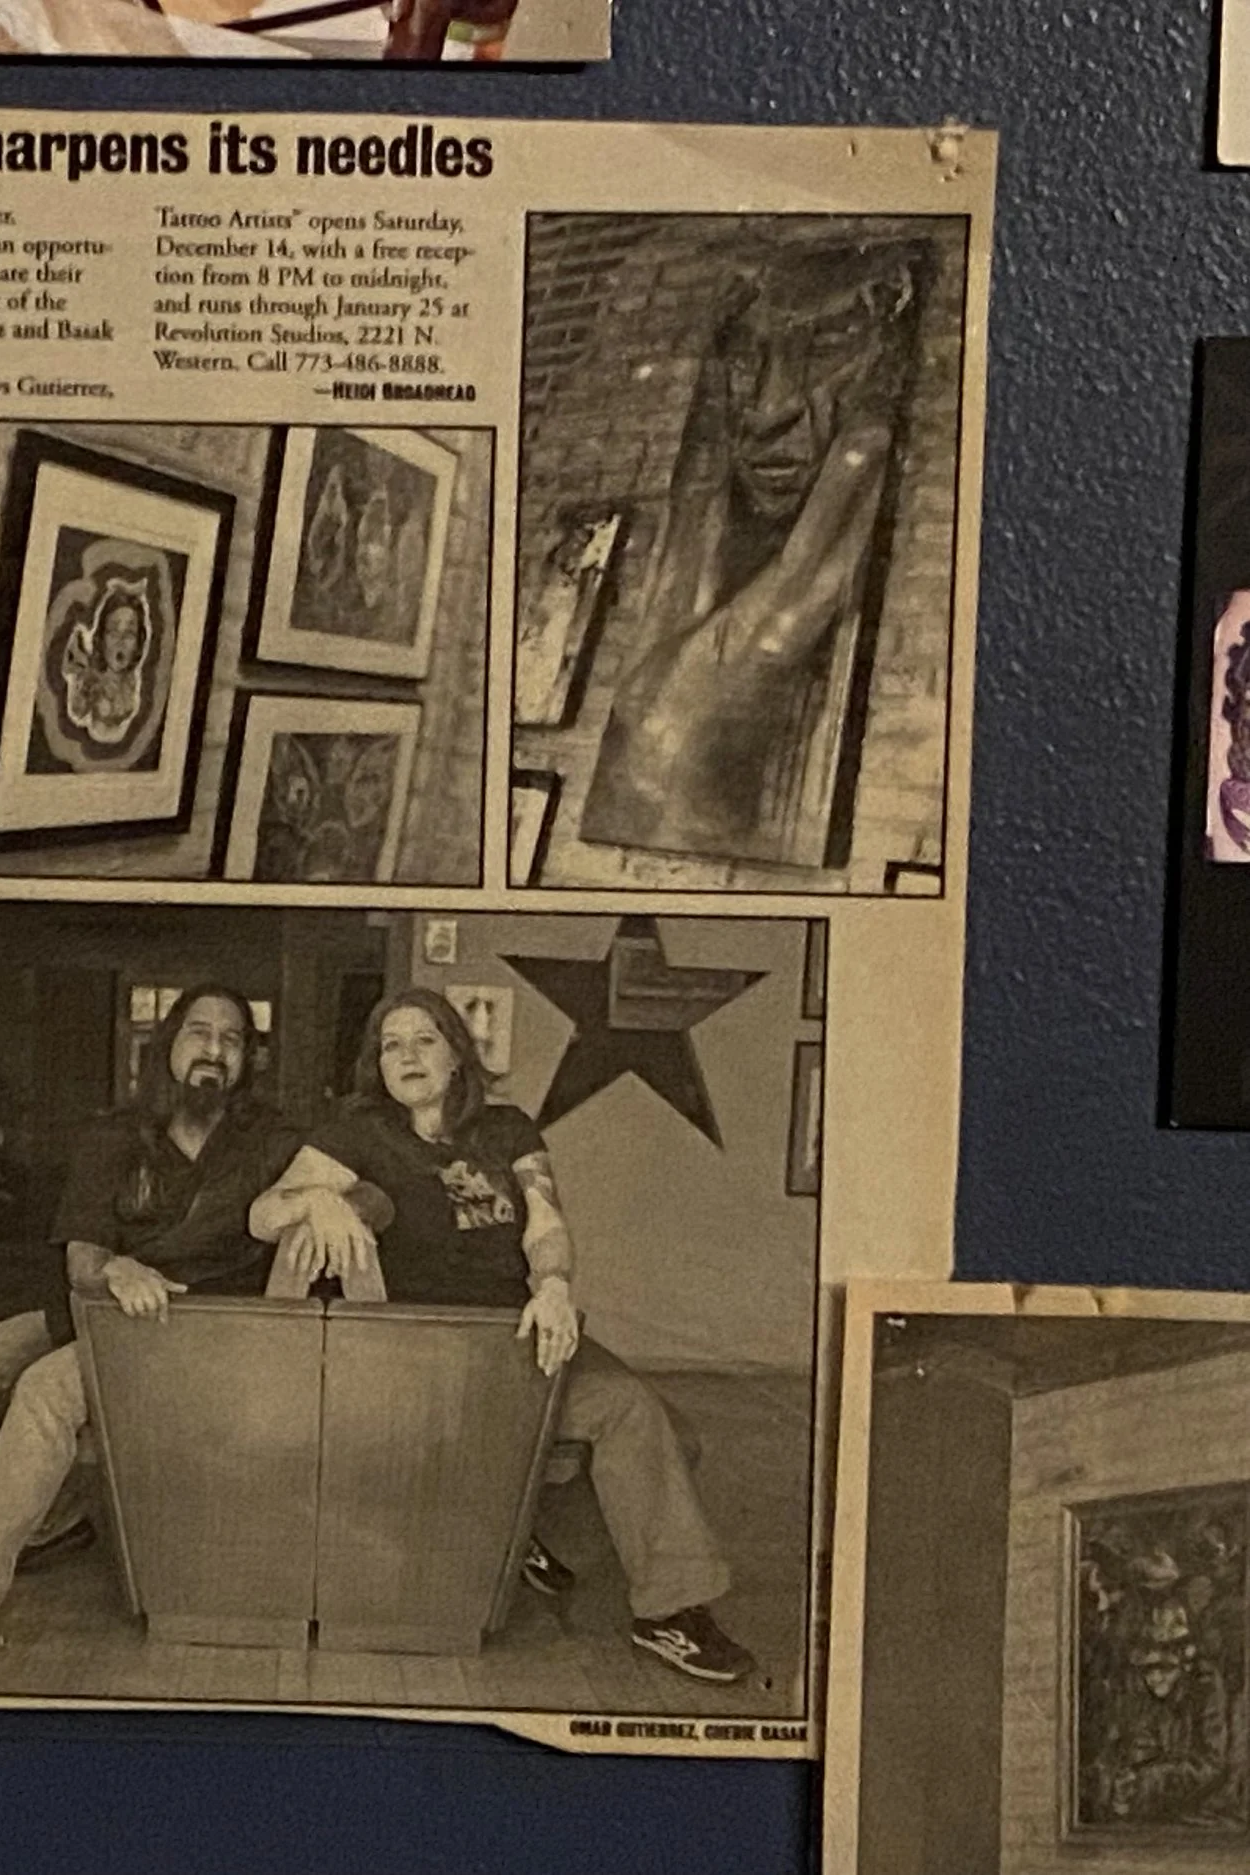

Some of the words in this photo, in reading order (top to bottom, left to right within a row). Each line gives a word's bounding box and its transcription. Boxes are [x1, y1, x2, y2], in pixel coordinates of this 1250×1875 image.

[208, 122, 277, 175] its
[296, 125, 493, 177] needles
[157, 207, 223, 227] Tattoo
[308, 216, 367, 236] opens
[155, 237, 257, 257] December
[302, 239, 347, 259] with
[353, 247, 366, 259] a
[372, 240, 409, 259] free
[35, 262, 83, 282] their
[154, 267, 195, 285] tion
[201, 266, 251, 286] from
[257, 267, 270, 286] 8
[278, 267, 315, 287] PM
[322, 272, 345, 287] to
[6, 291, 30, 310] of
[34, 291, 68, 311] the
[152, 293, 192, 313] and
[197, 301, 242, 313] runs
[249, 295, 329, 322] through
[336, 296, 412, 323] January
[419, 297, 444, 316] 25
[451, 302, 470, 317] at
[12, 319, 50, 339] and
[57, 320, 115, 340] Basak
[153, 321, 264, 342] Revolution
[357, 325, 405, 345] 2221
[246, 352, 289, 372] Call
